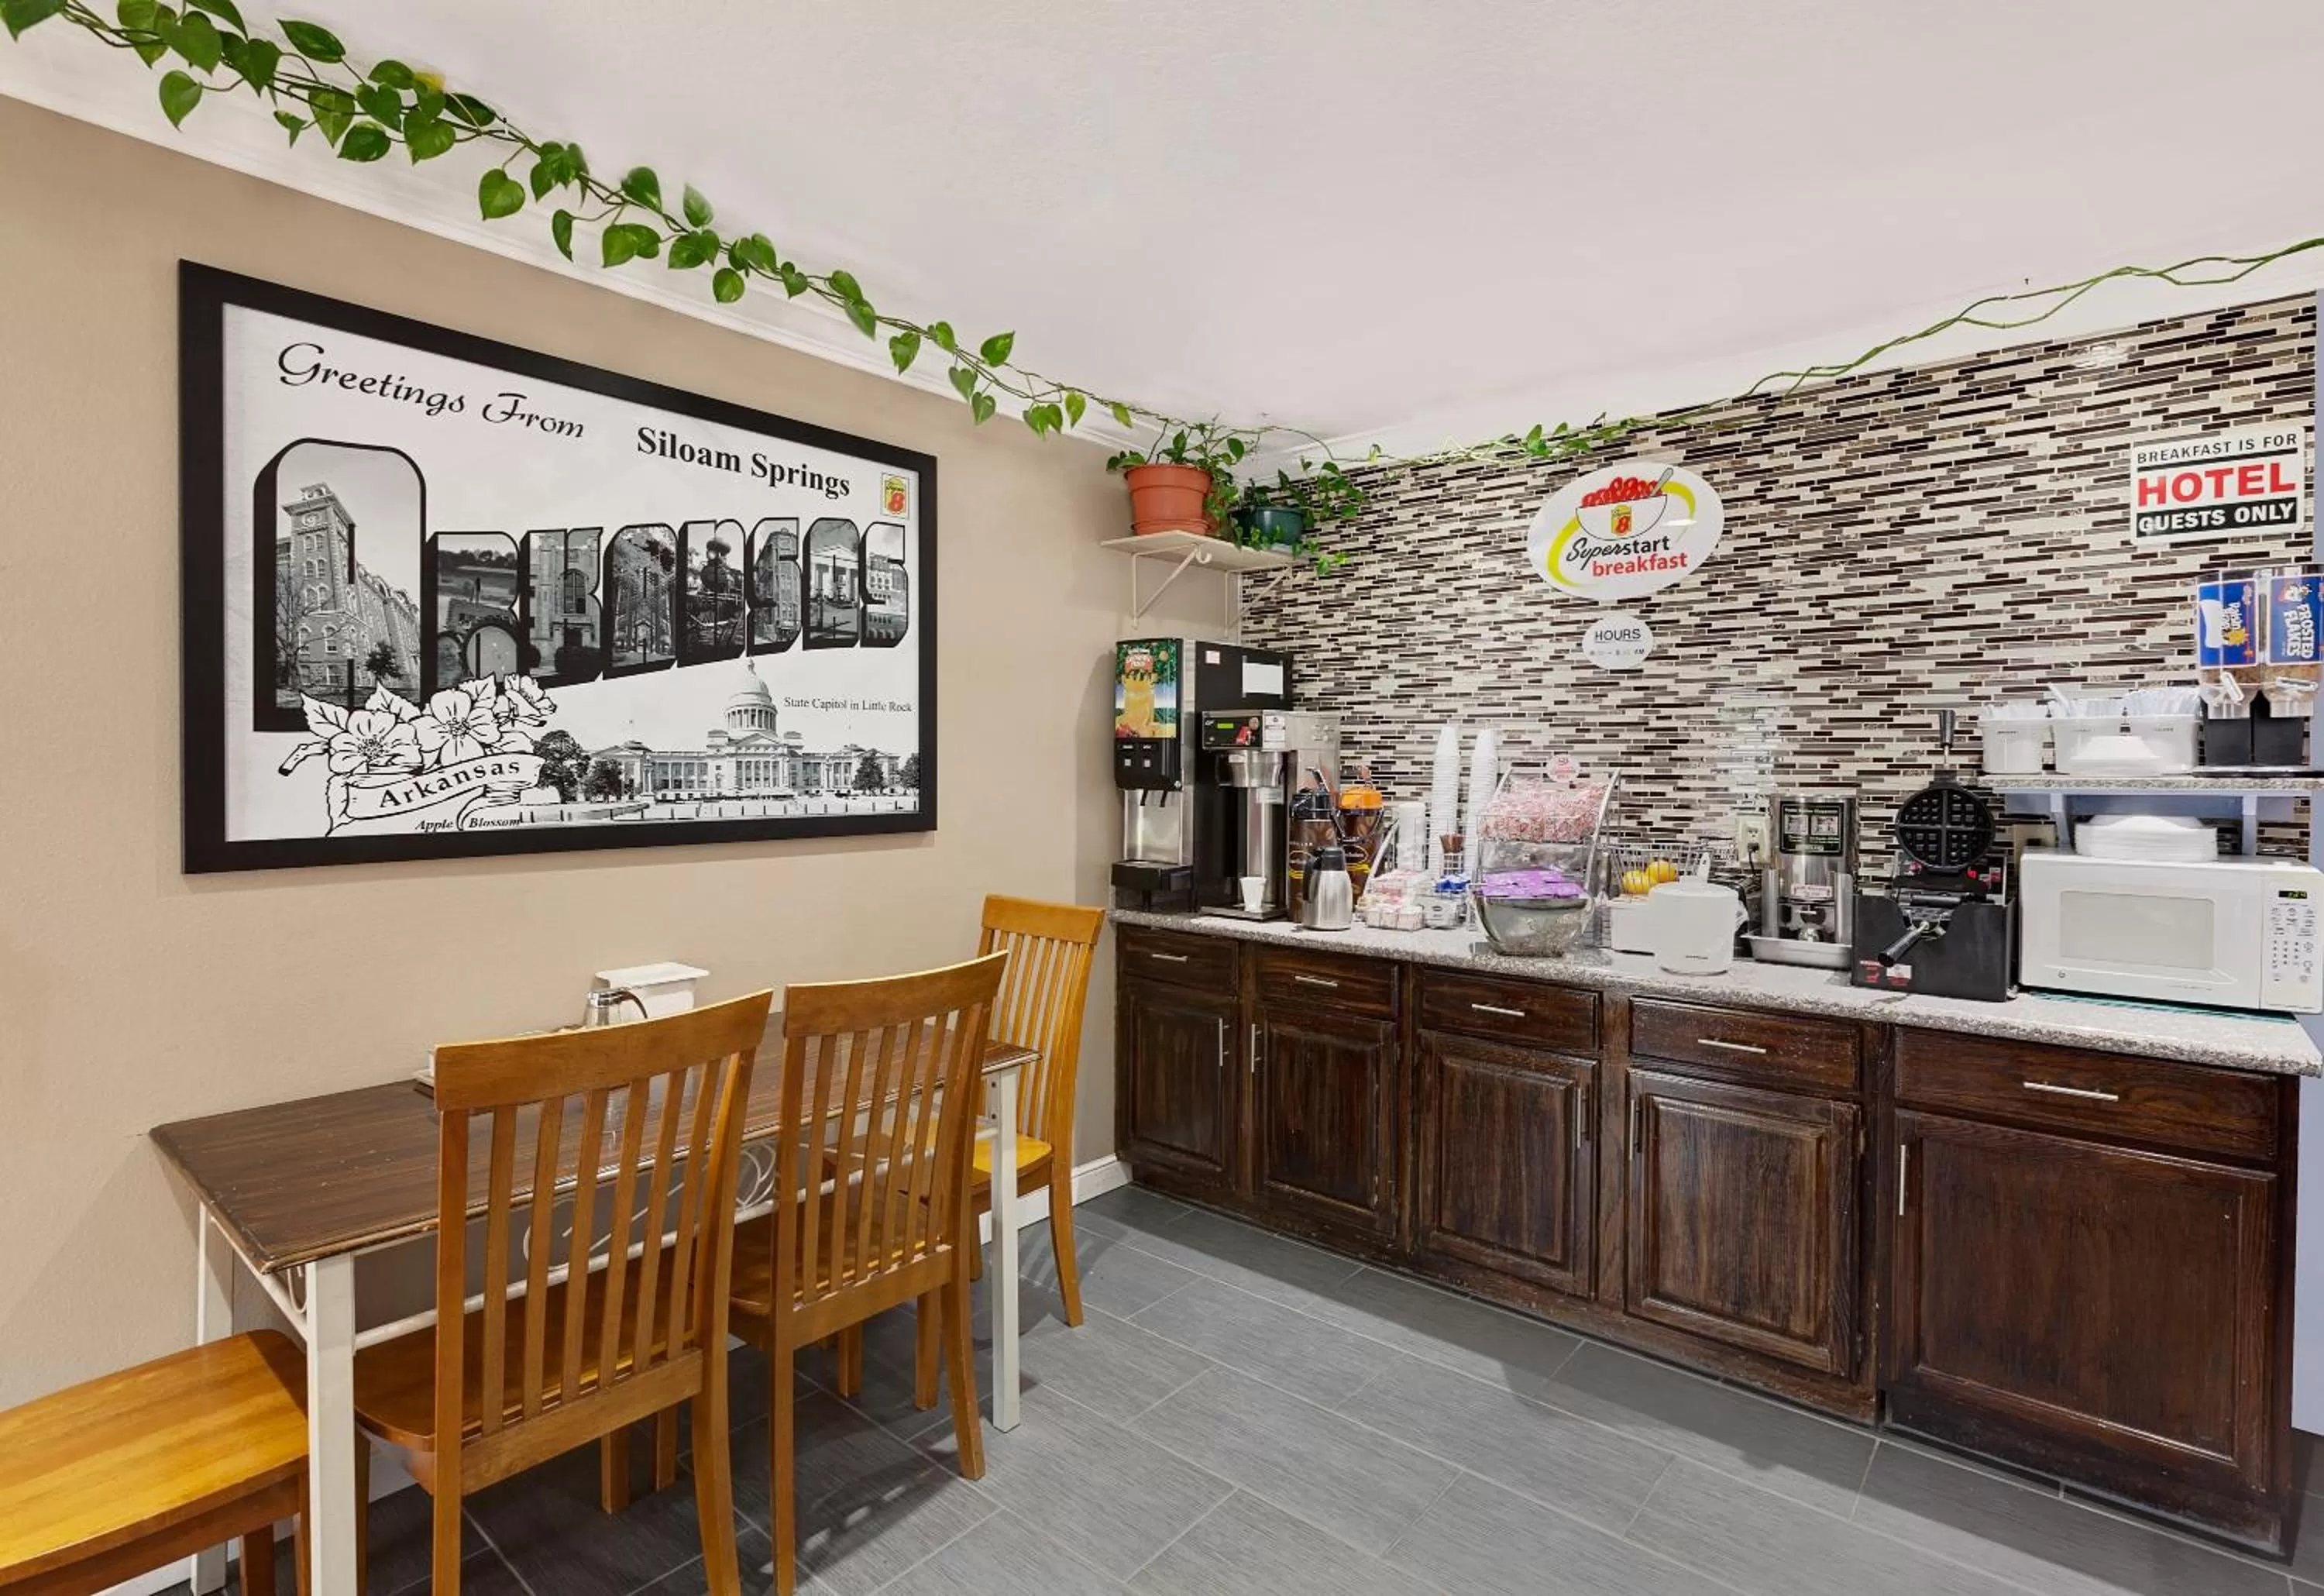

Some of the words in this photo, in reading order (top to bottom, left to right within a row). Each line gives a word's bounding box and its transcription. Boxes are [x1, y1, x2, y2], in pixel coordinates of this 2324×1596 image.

[278, 342, 466, 417] Greetings
[482, 393, 584, 438] From
[638, 426, 742, 473] Siloam
[751, 452, 851, 500] Springs
[2137, 441, 2232, 464] BREAKFAST
[2239, 439, 2255, 451] IS
[2263, 433, 2298, 449] FOR
[2138, 463, 2296, 507] HOTEL
[2138, 509, 2226, 534] GUESTS
[2234, 502, 2295, 524] ONLY
[1566, 535, 1670, 571] Superstart
[1593, 552, 1688, 577] breakfast
[1594, 628, 1642, 641] HOURS
[2284, 610, 2302, 657] FLAKES
[2296, 603, 2315, 659] FROSTED
[783, 697, 810, 708] State
[813, 698, 847, 712] Capitol
[850, 700, 859, 710] in
[862, 700, 887, 711] Little
[889, 700, 912, 712] Rock
[380, 761, 521, 808] Arkansas
[414, 819, 454, 833] Apple
[469, 817, 521, 829] Blossom
